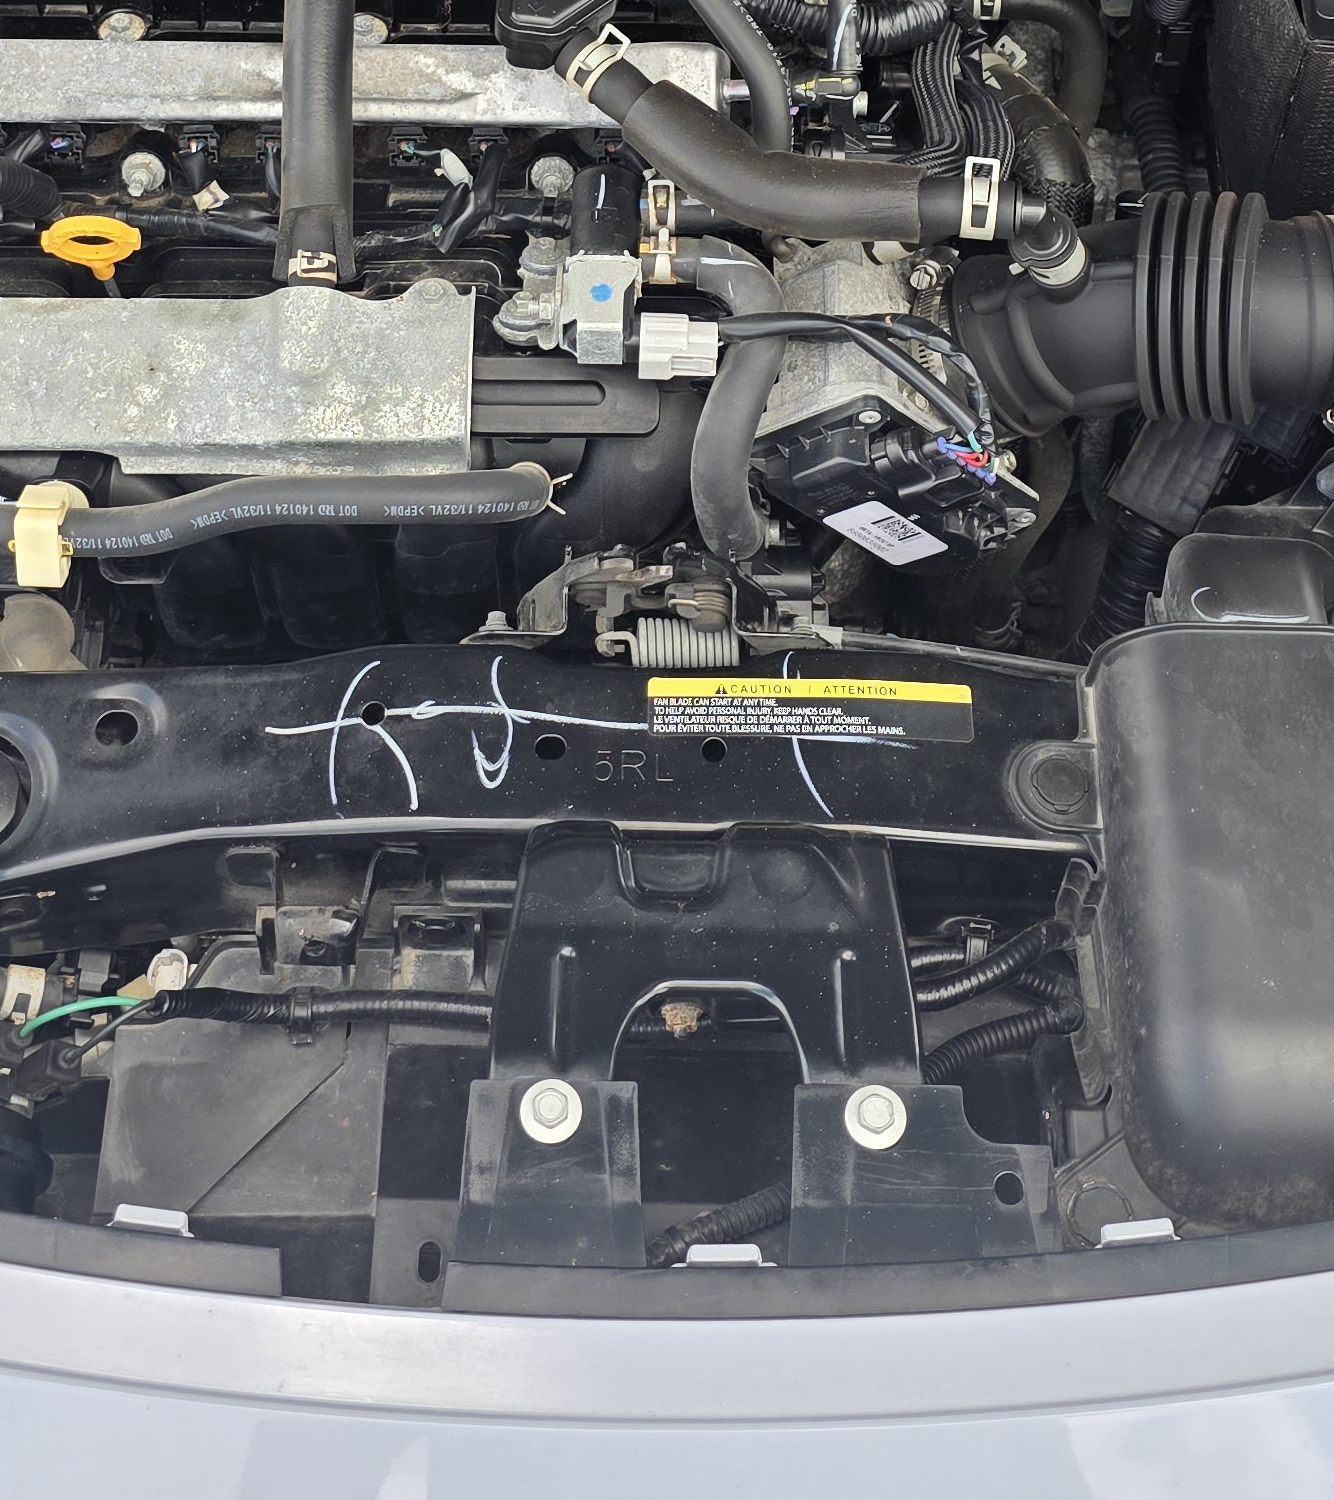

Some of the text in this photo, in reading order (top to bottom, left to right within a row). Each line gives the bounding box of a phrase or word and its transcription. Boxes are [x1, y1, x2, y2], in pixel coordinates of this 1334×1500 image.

[274, 503, 316, 516] 140124
[338, 505, 358, 517] DOT
[476, 502, 515, 515] 140124
[155, 527, 174, 542] DOT
[105, 534, 139, 549] 140124
[730, 684, 792, 694] CAUTION
[823, 685, 897, 696] ATTENTION
[653, 698, 779, 707] FAN BLADE CAN START AT ANY TIME.
[654, 707, 844, 716] TO HELP AVOID PERSONAL INJURY, KEEP HANDS CLEAR.
[653, 715, 664, 723] LE
[664, 715, 716, 724] VENTILATEUR
[716, 715, 746, 724] RISQUE
[747, 716, 758, 724] DE
[759, 714, 803, 724] DÉMARRER
[810, 716, 833, 724] TOUT
[653, 723, 907, 736] POUR ÉVITER TOUTE BLESSURE, NE PAS EN APPROCHER LES MAINS.
[594, 750, 675, 782] 5RL
